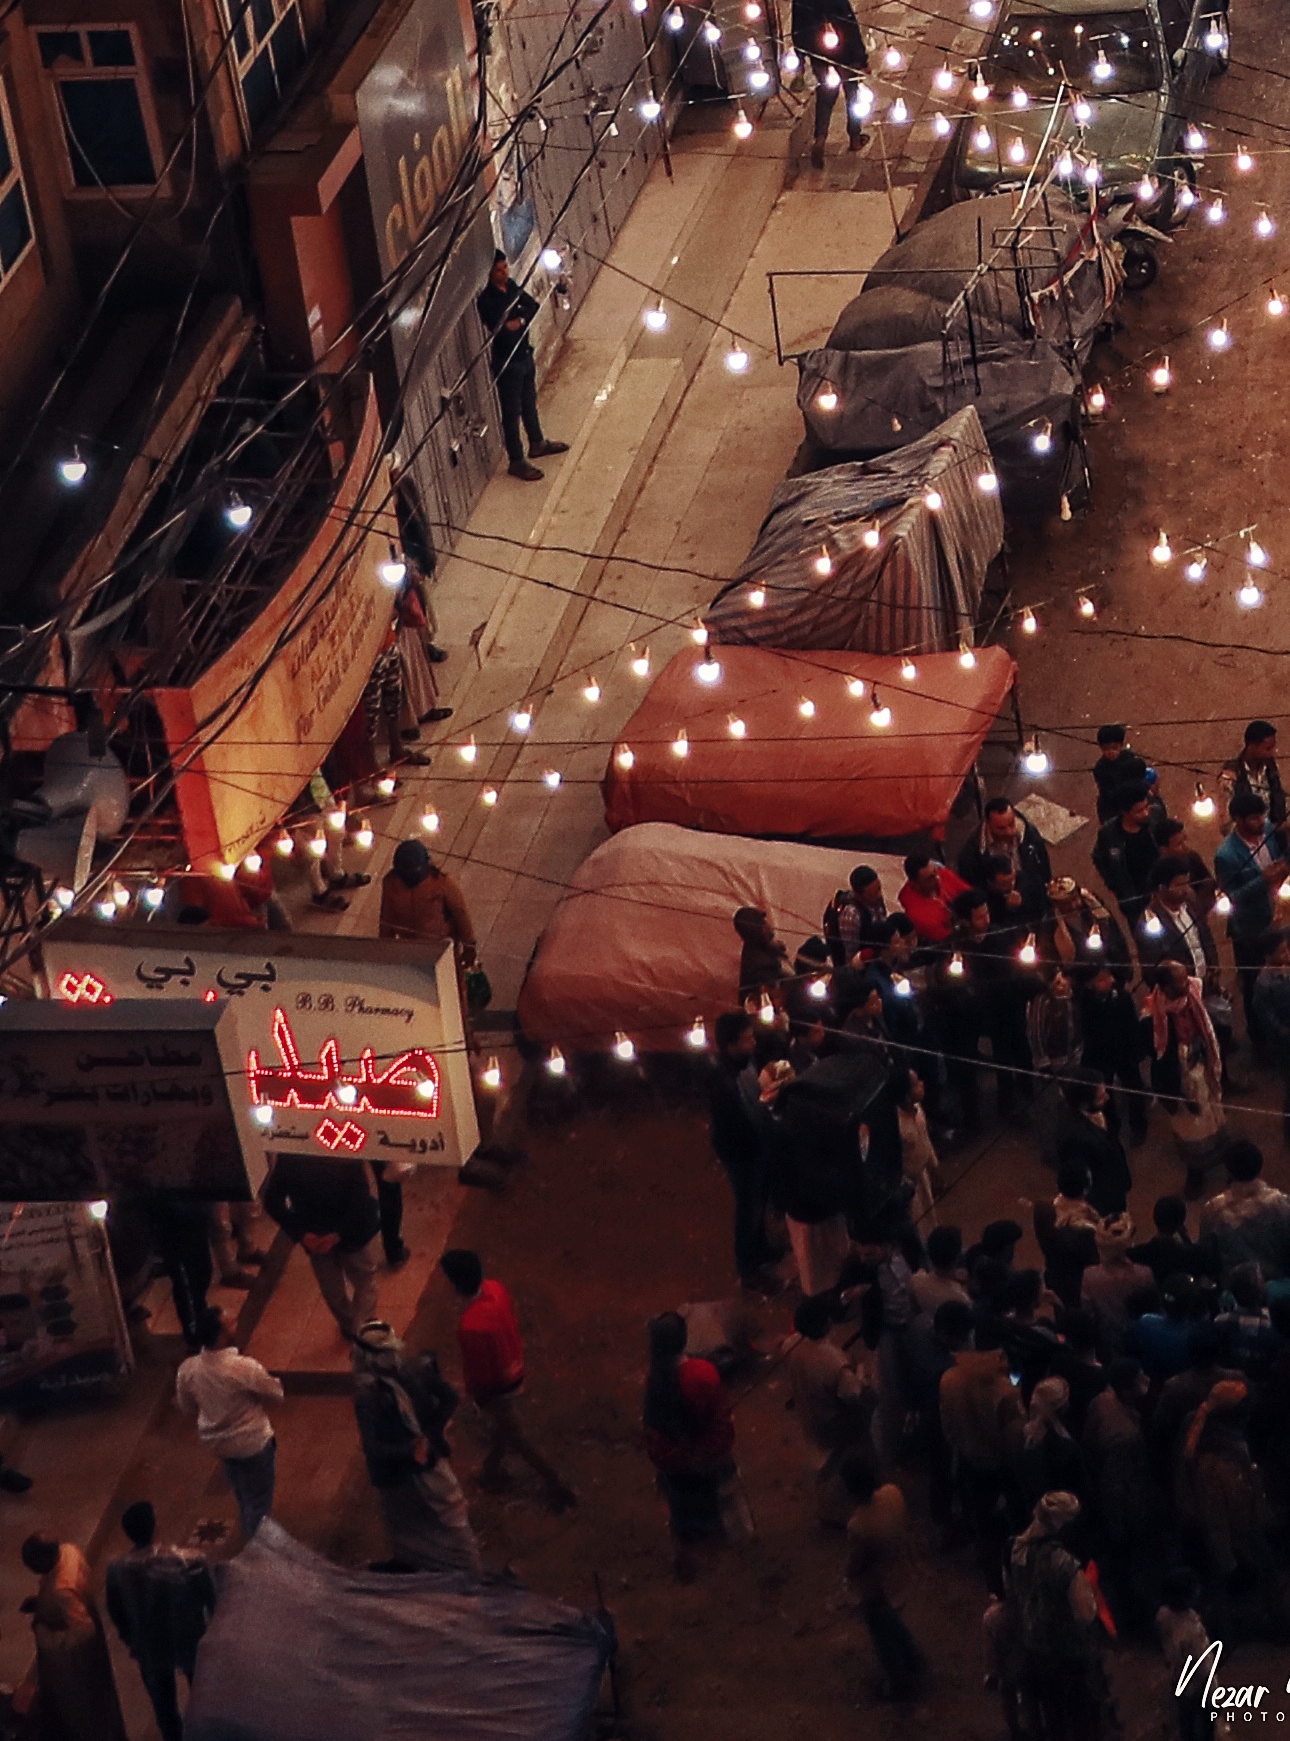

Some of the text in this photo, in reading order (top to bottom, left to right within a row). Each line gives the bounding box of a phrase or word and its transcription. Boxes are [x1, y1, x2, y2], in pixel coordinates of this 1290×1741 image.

[135, 955, 278, 994] بي بي
[344, 994, 415, 1023] Pharmacy
[377, 1129, 446, 1154] أدوية
